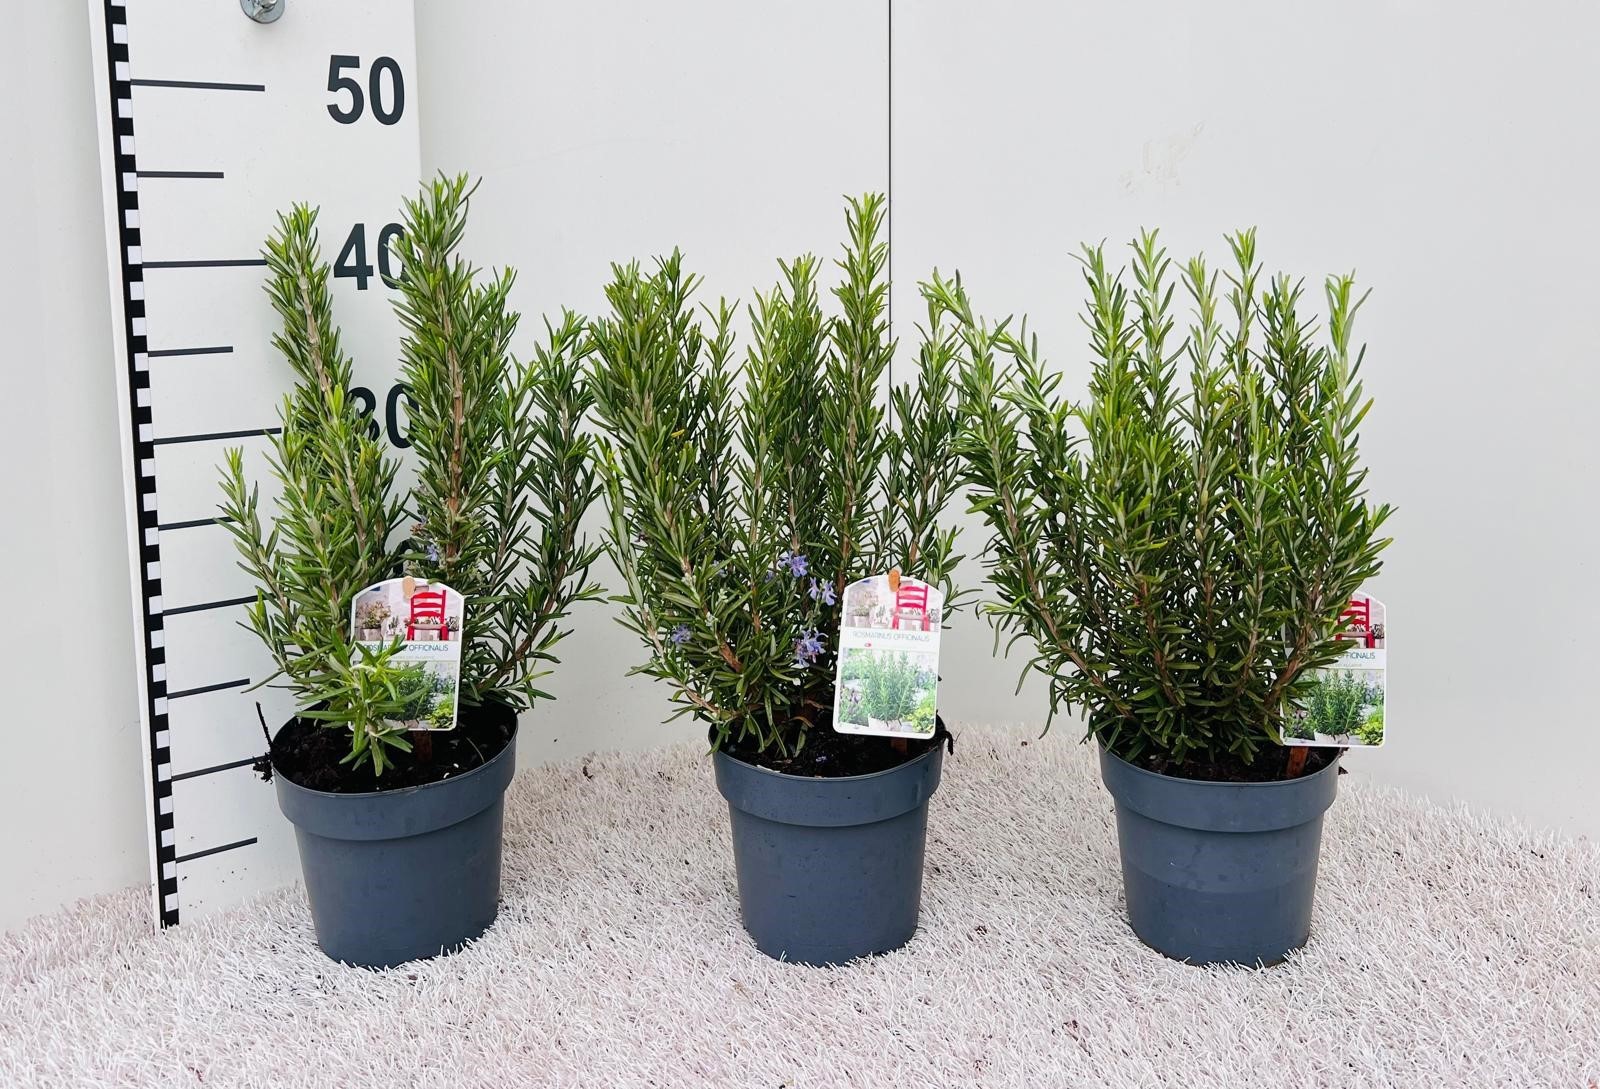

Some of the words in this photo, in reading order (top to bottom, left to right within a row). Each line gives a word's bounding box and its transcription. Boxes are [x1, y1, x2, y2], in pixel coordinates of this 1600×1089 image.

[326, 54, 405, 126] 50
[333, 222, 414, 290] 40
[346, 384, 419, 448] 30
[408, 644, 449, 652] OFFICINALIS
